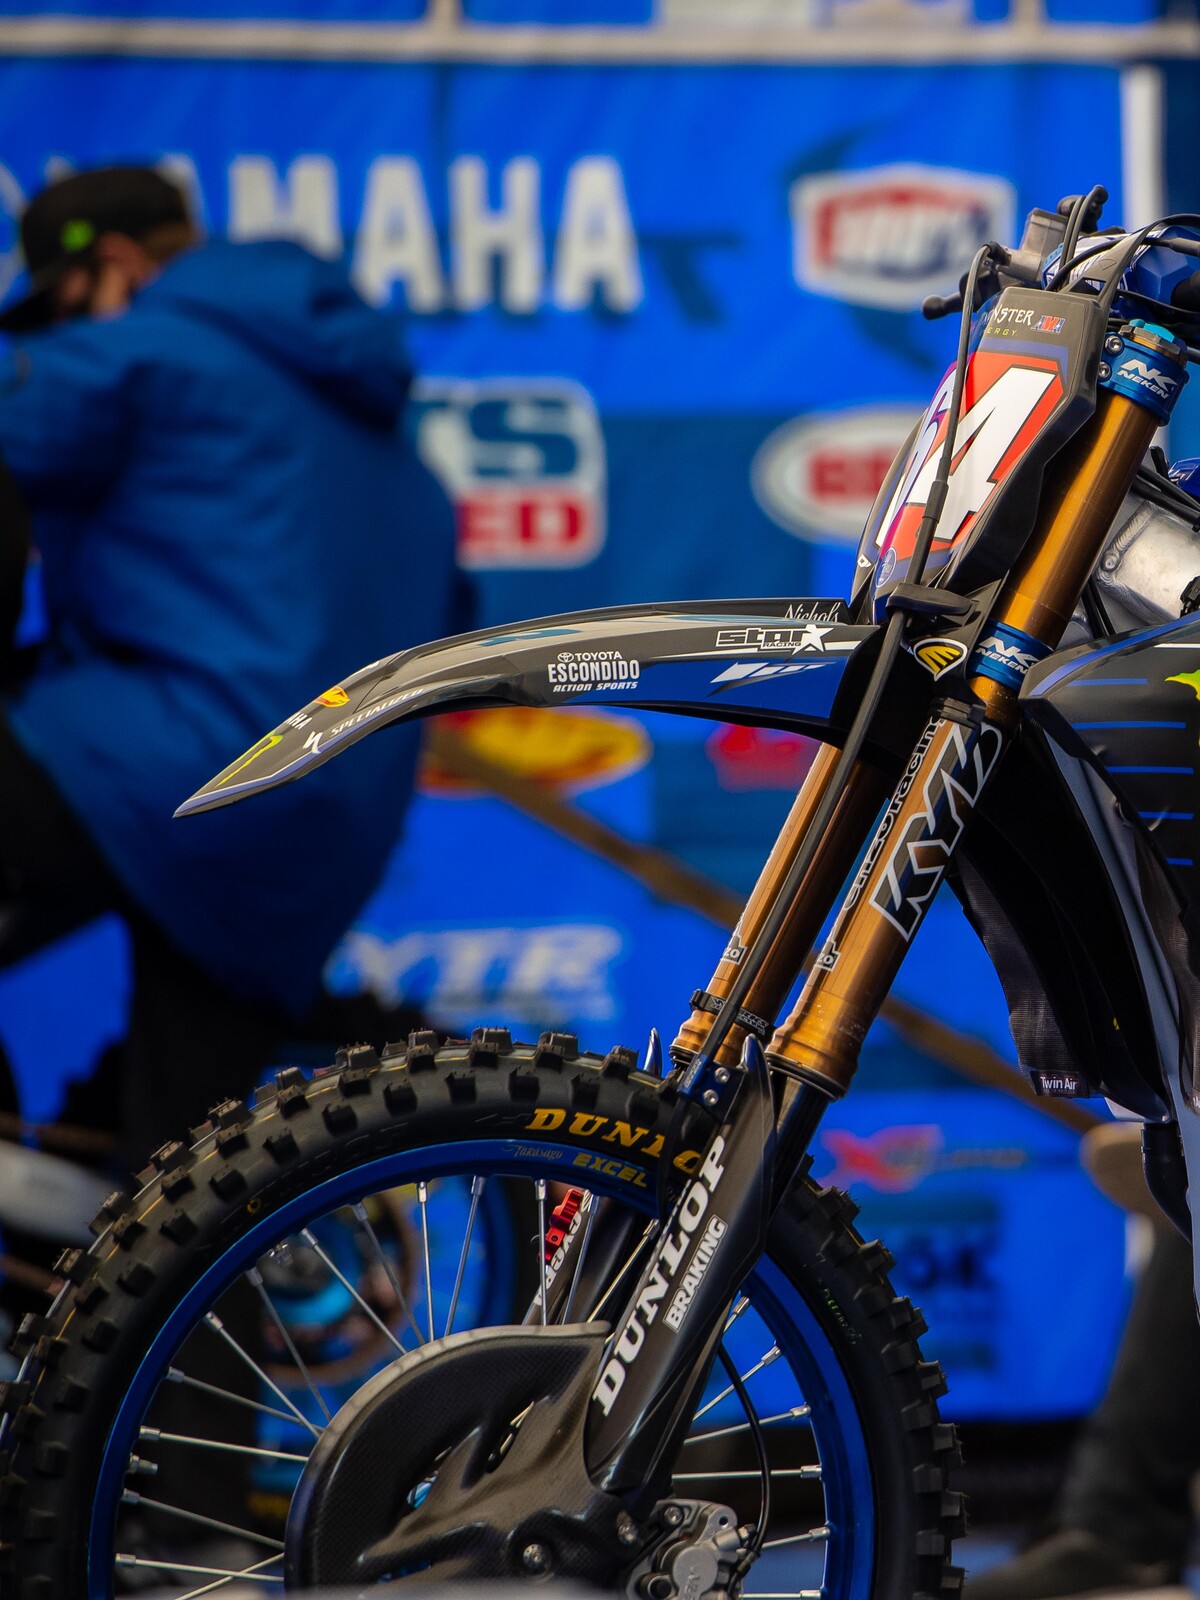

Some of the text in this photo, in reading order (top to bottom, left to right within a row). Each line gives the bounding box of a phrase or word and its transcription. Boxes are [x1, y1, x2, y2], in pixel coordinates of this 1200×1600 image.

[1117, 370, 1169, 399] NEKEN
[784, 601, 840, 624] Nichols
[574, 650, 623, 662] TOYOTA
[763, 641, 801, 649] RACING
[547, 659, 640, 684] ESCONDIDO
[975, 647, 1030, 675] NEKEN
[553, 680, 638, 693] ACTION SPORTS
[329, 688, 424, 737] SPECIALIZED
[1040, 1076, 1063, 1090] Twin
[1064, 1077, 1078, 1091] Air
[571, 1151, 648, 1188] EXCEL
[592, 1135, 725, 1416] DUNLOP
[665, 1216, 726, 1331] BRAKING
